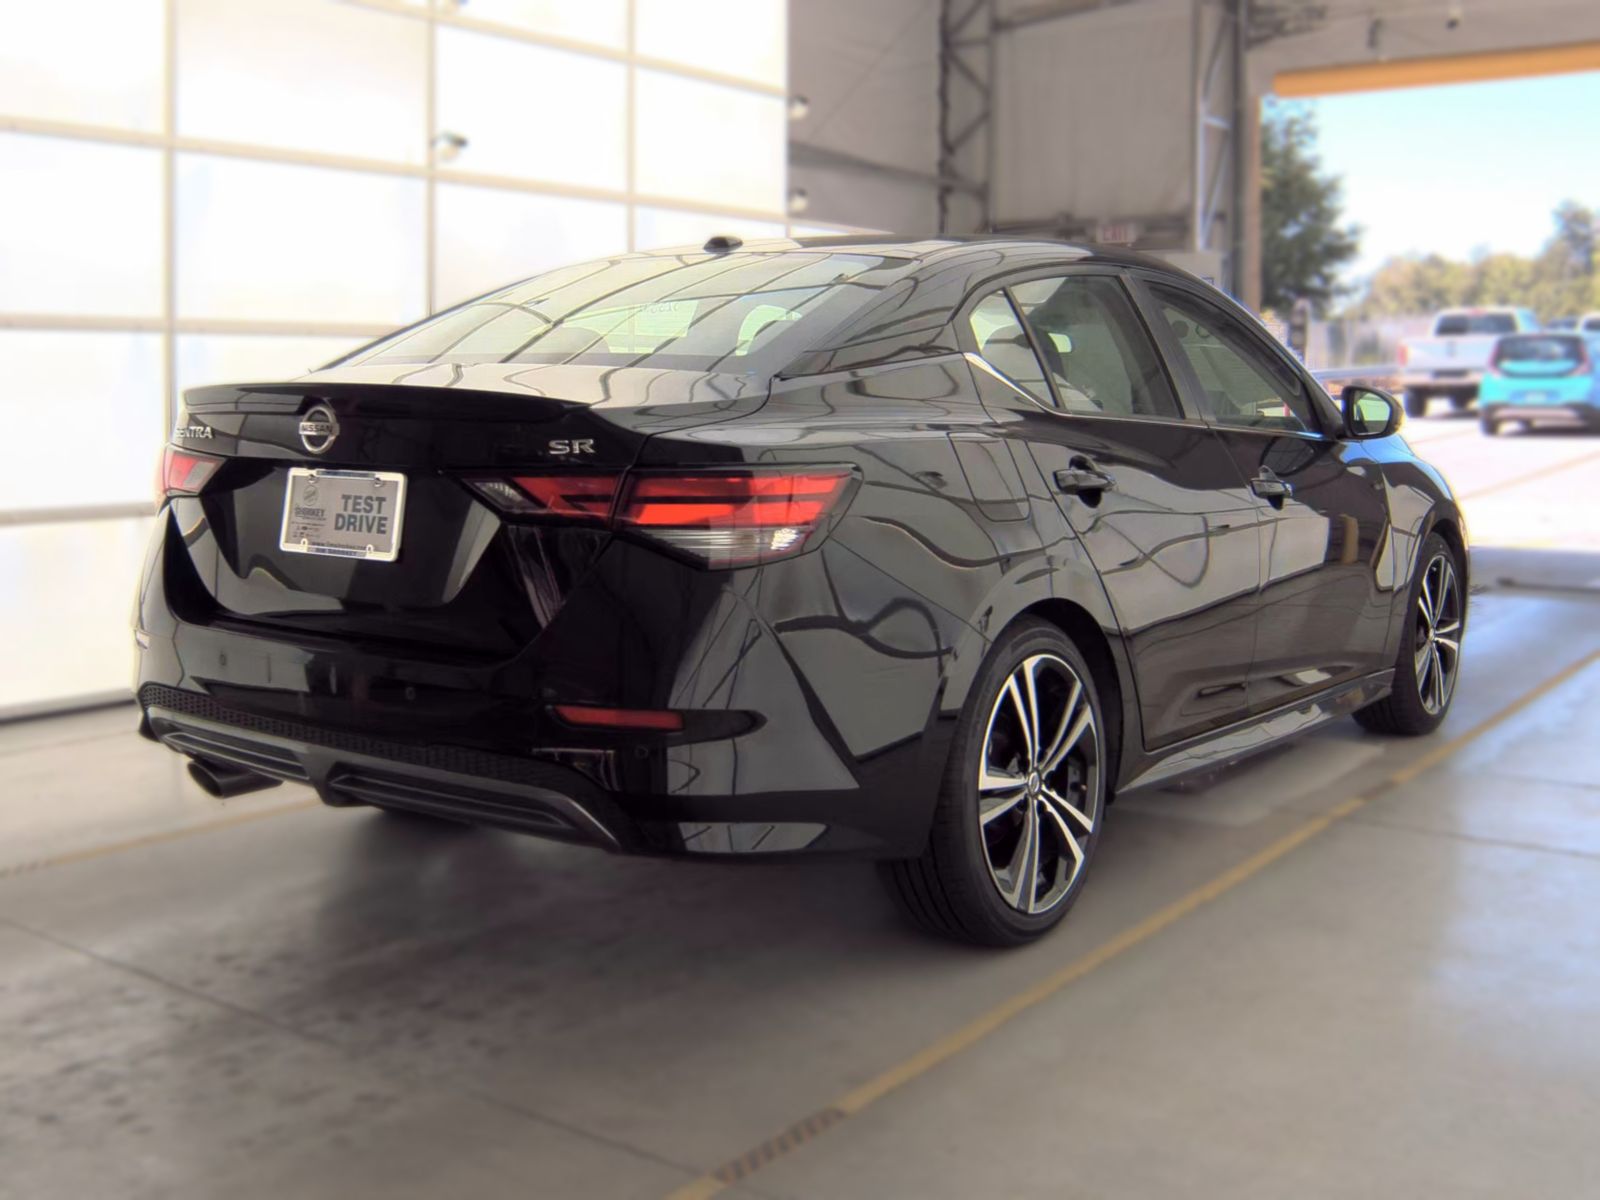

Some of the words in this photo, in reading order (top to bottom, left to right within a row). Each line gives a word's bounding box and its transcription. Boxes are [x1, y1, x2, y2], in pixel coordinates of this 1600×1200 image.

[174, 425, 213, 439] SENTRA
[301, 424, 332, 433] NISSAN
[548, 438, 596, 455] SR
[341, 494, 387, 515] TEST
[333, 513, 388, 535] DRIVE
